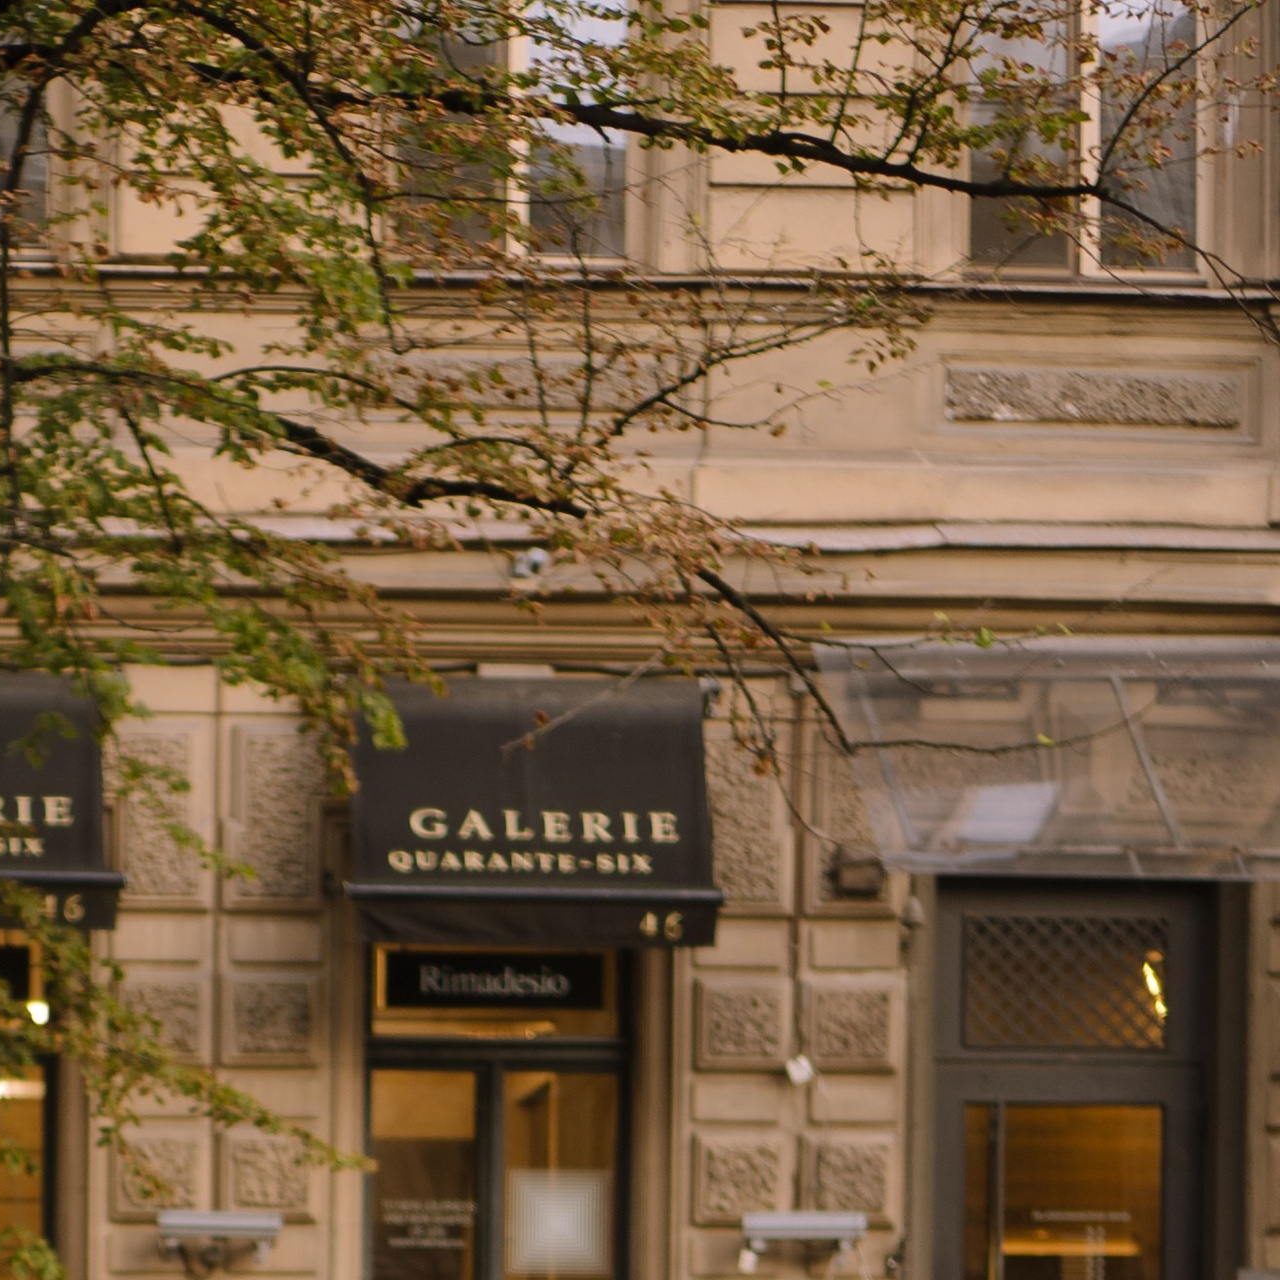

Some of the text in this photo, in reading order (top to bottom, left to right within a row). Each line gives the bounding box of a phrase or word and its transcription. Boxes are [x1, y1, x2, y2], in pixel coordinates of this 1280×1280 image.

[409, 807, 680, 843] GALERIE
[387, 850, 654, 874] QUARANTE-SIX
[639, 910, 684, 941] 46
[419, 963, 570, 996] Rimadesio
